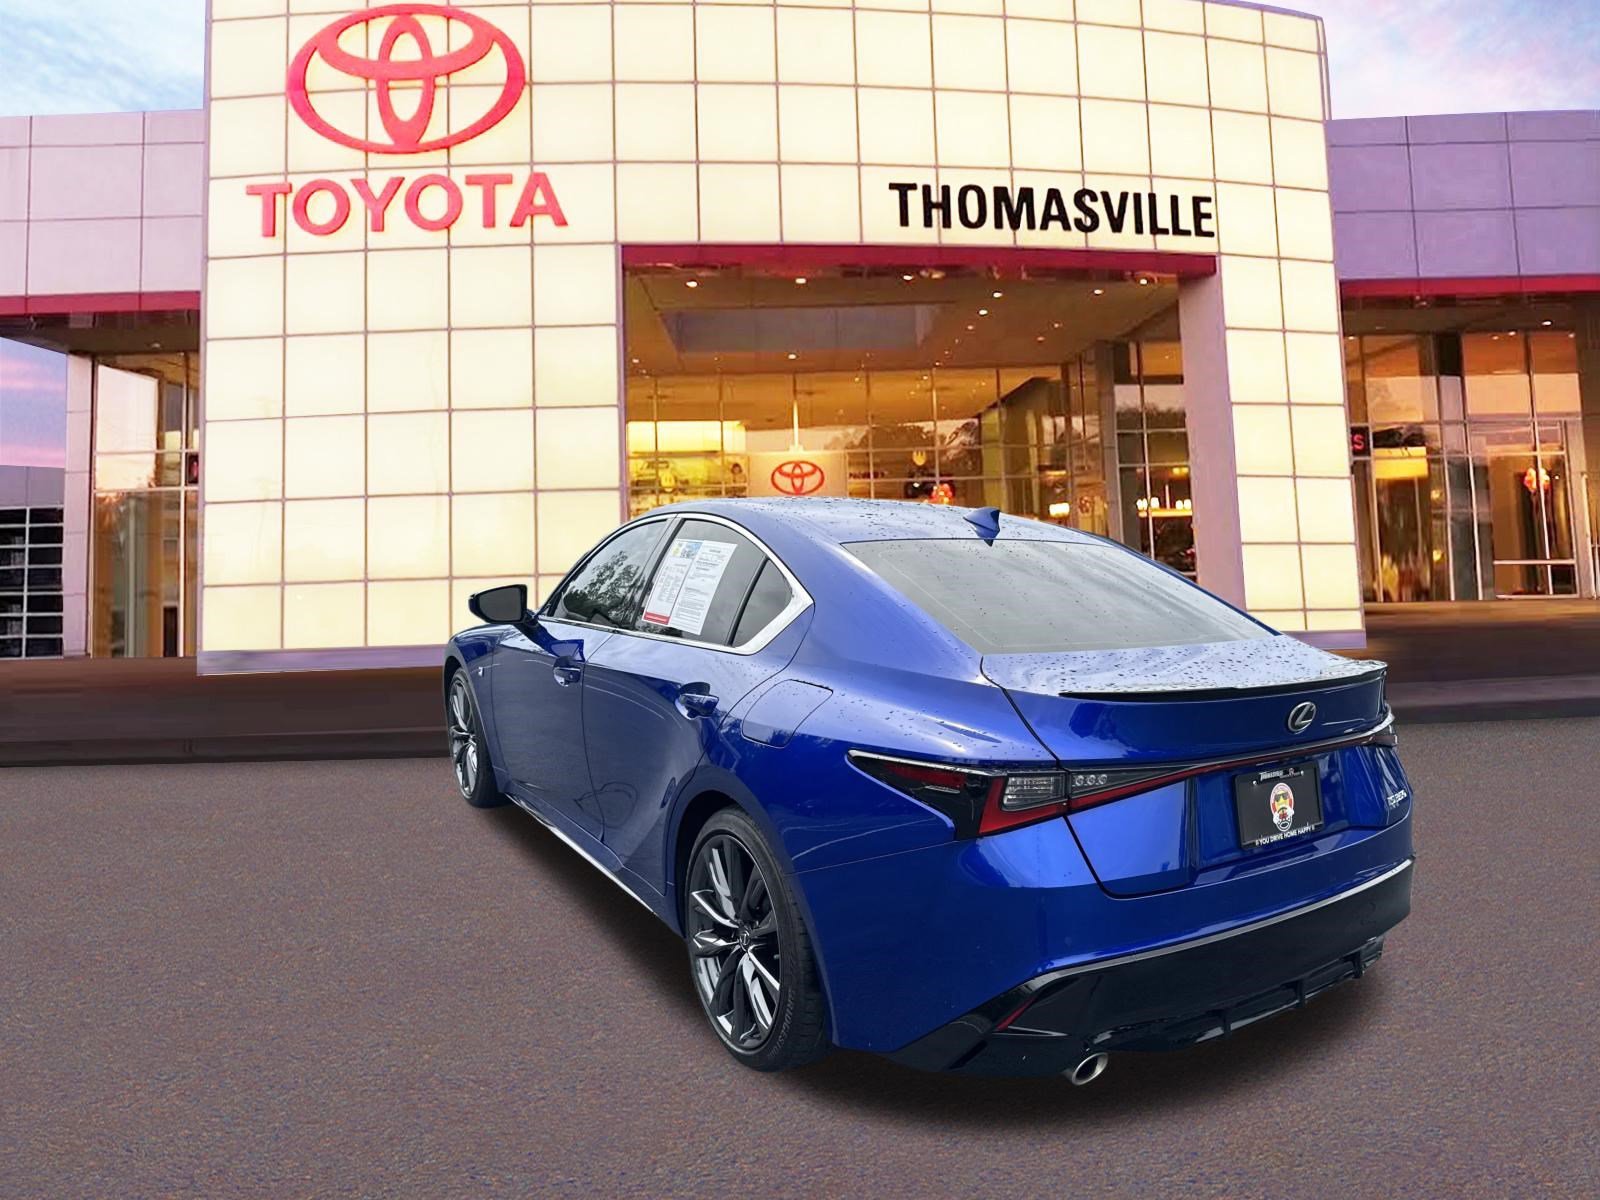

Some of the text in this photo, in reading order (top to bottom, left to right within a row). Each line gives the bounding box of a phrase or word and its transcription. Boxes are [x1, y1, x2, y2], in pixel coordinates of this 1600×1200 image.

[246, 172, 568, 237] TOYOTA
[889, 183, 1215, 237] THOMASVILLE
[1259, 836, 1270, 846] YOU
[1283, 829, 1298, 839] HOME
